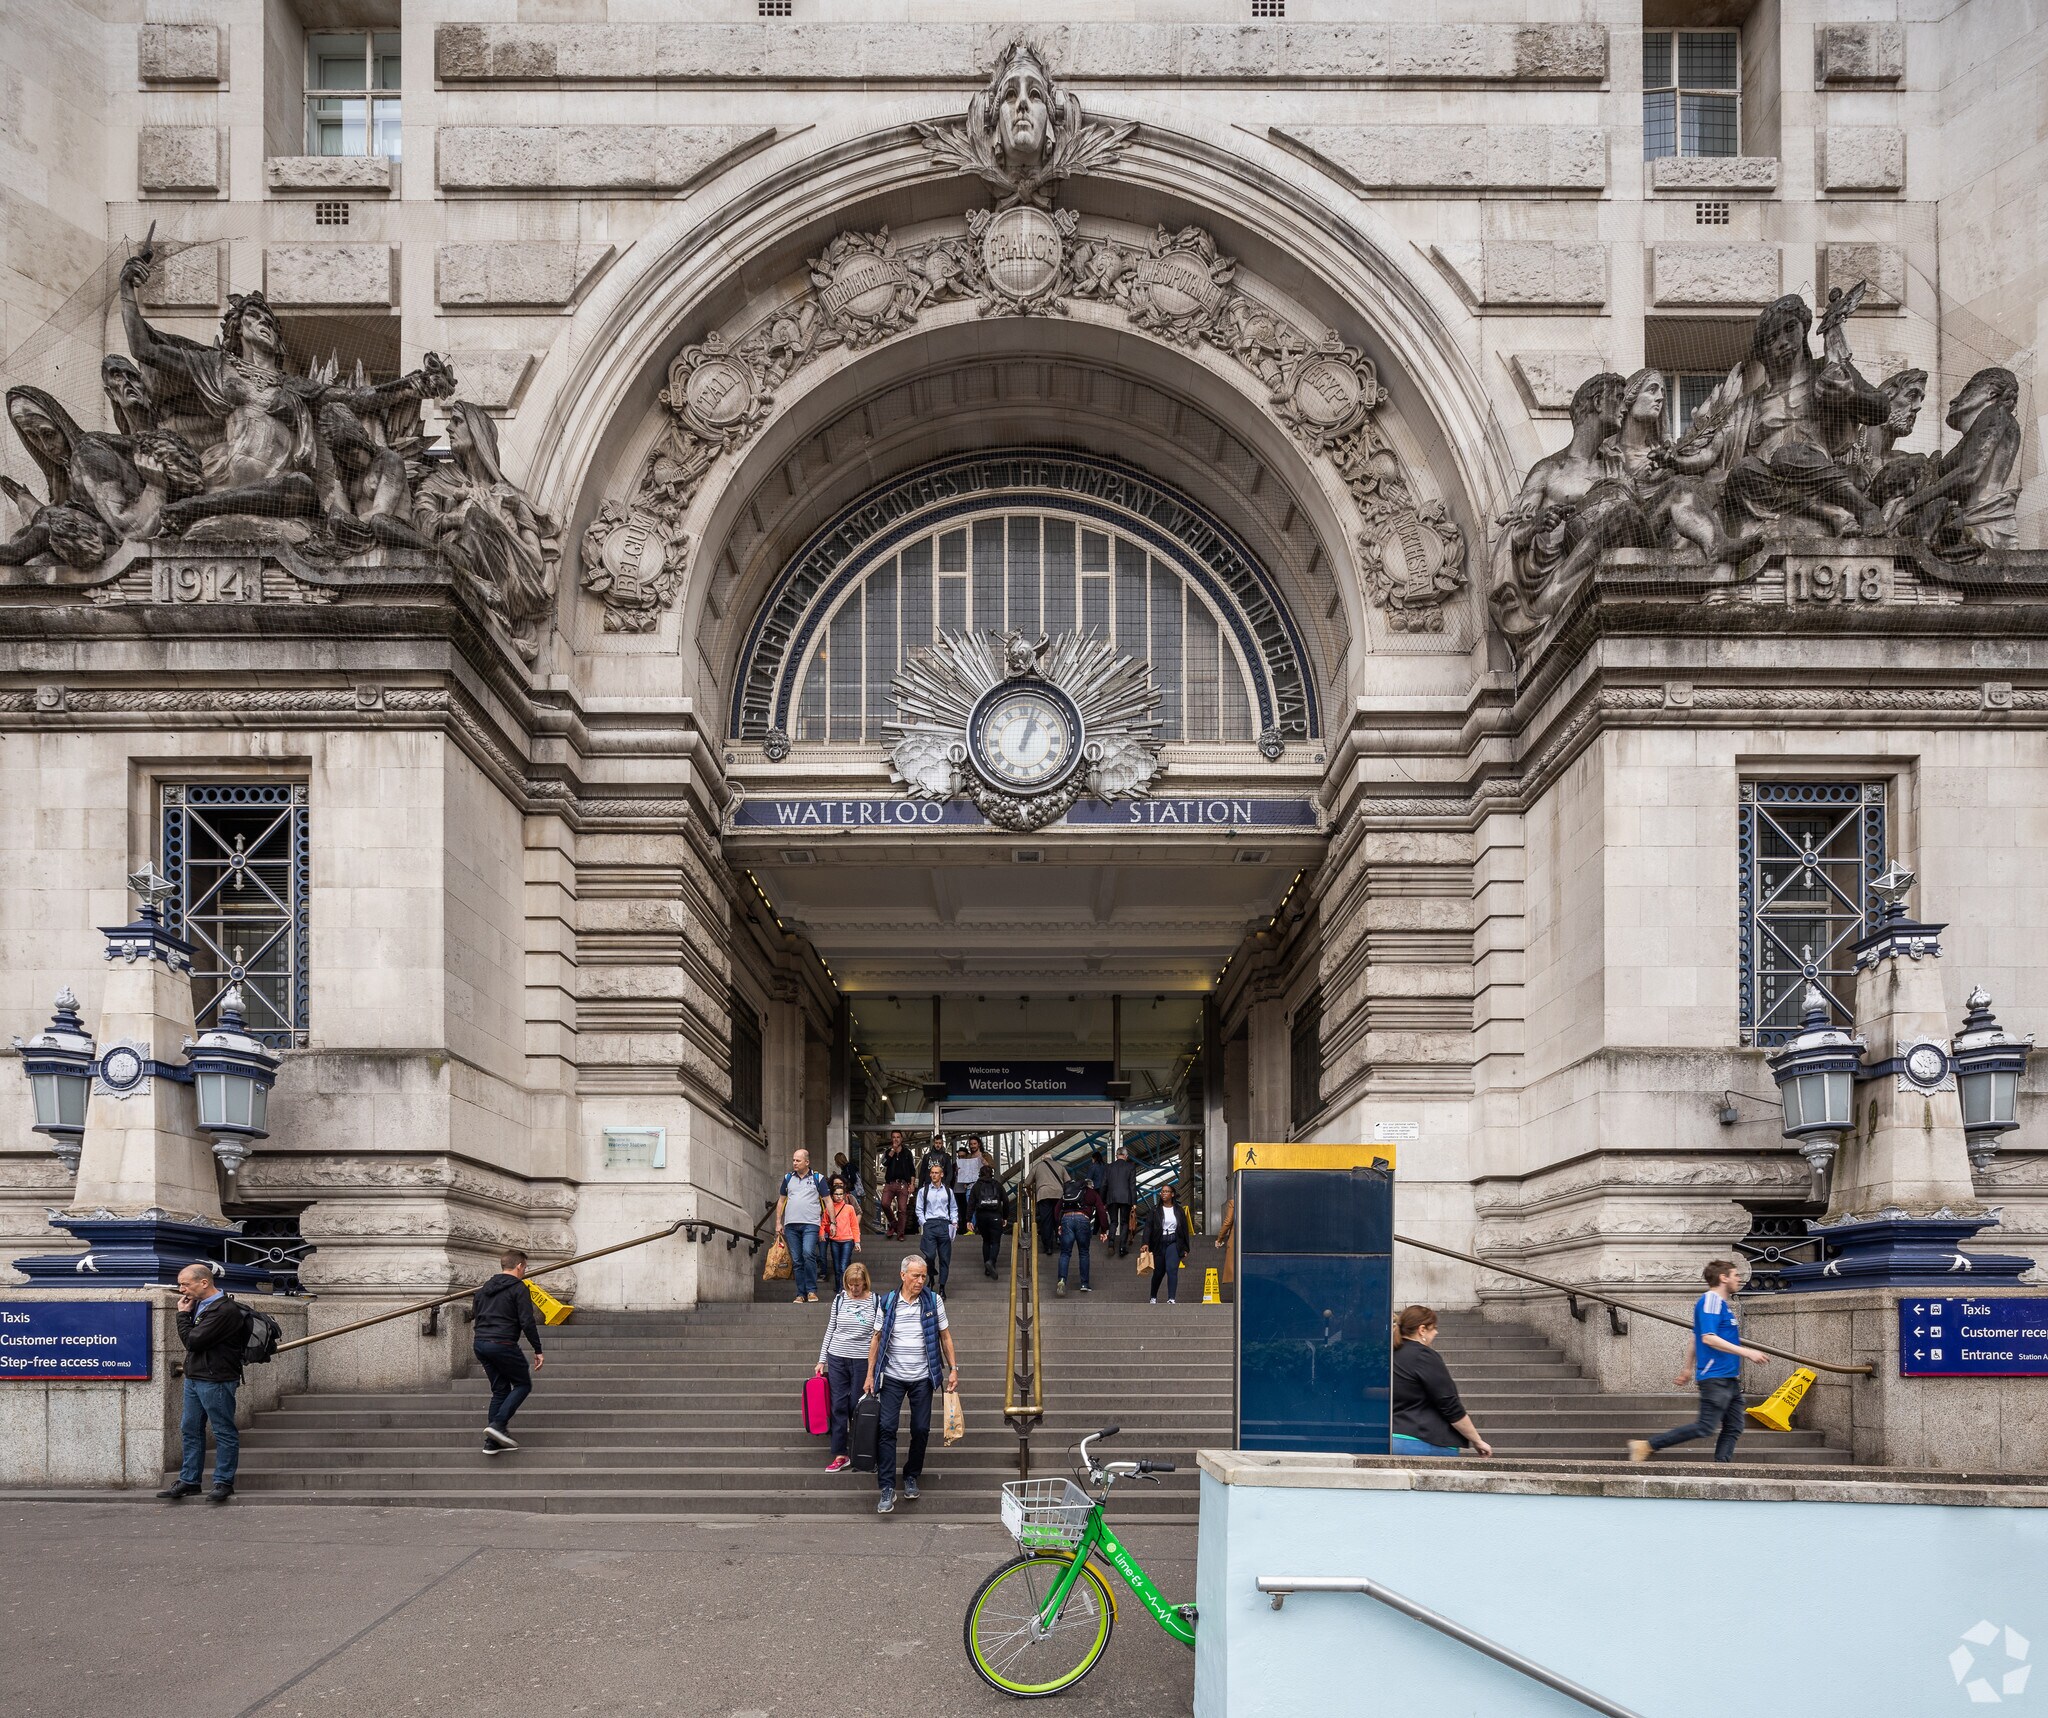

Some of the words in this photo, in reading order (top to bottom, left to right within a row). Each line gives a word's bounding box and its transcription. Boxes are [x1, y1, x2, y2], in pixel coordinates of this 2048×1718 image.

[989, 233, 1057, 270] FRANCE
[1140, 260, 1221, 308] MESOPOTAMIA
[694, 366, 741, 418] ITALY
[1303, 366, 1353, 417] EGYPT
[968, 460, 992, 491] OF
[1002, 459, 1050, 487] THE
[1060, 463, 1168, 519] COMPANY
[836, 469, 959, 550] EMPLOYEES
[1168, 507, 1217, 554] WHO
[616, 513, 656, 593] BELGIUM
[795, 541, 844, 589] THE
[160, 566, 252, 603] 1914
[1208, 546, 1259, 601] FELL
[1794, 564, 1883, 602] 1918
[775, 585, 811, 616] TO
[1244, 595, 1278, 627] IN
[1258, 623, 1298, 676] THE
[741, 617, 794, 741] DEDICATED
[1276, 680, 1307, 733] WAR
[775, 801, 944, 825] WATERLOO
[1129, 801, 1252, 823] STATION
[968, 1066, 1001, 1074] Welcome
[968, 1079, 1022, 1090] Waterloo
[1024, 1078, 1067, 1090] Station
[0, 1311, 30, 1323] Taxis
[1961, 1303, 1991, 1315] Taxis
[0, 1334, 58, 1346] Customer
[61, 1334, 118, 1347] reception
[1961, 1326, 2019, 1338] Customer
[0, 1356, 57, 1370] Step-free
[60, 1358, 99, 1367] access
[102, 1360, 116, 1368] (100
[117, 1360, 132, 1368] mts)
[1961, 1349, 2013, 1360] Entrance
